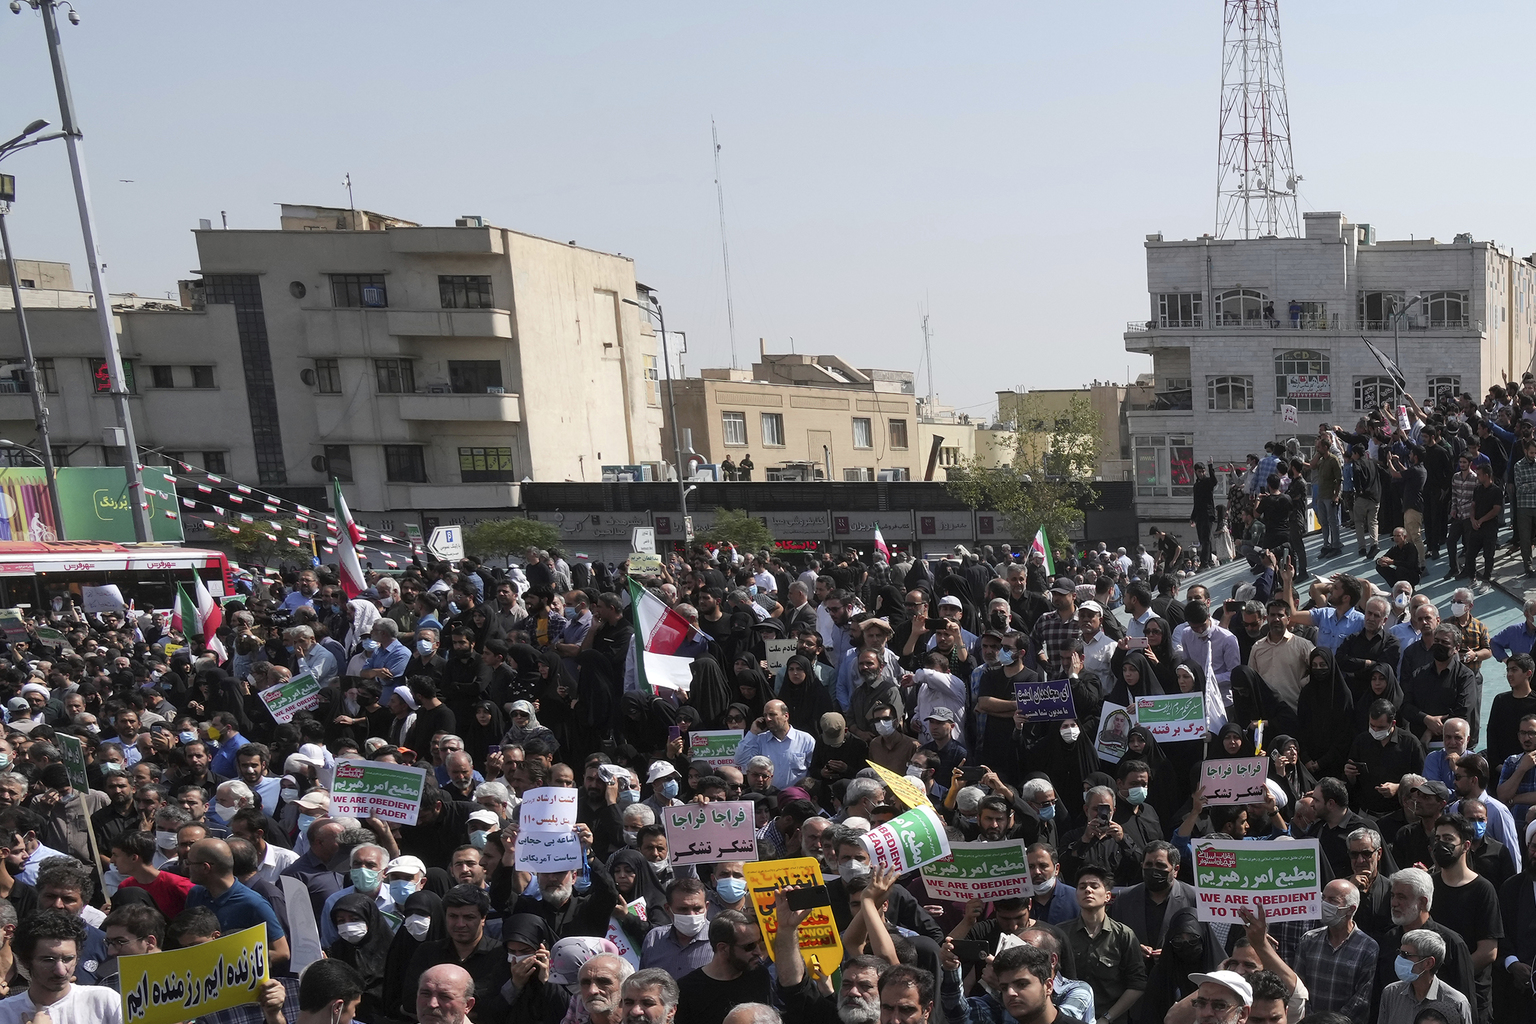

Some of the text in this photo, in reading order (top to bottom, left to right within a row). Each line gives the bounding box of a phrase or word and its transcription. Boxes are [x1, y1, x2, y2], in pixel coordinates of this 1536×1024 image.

[274, 705, 296, 718] WE ARE
[1183, 723, 1204, 736] مرگ
[1206, 761, 1262, 780] فراجا فراجا
[388, 784, 419, 796] مطیع
[1233, 785, 1264, 802] تشکر
[349, 796, 367, 804] ARE
[369, 797, 417, 811] OBEDIENT
[371, 807, 407, 820] EADER
[671, 807, 746, 830] فراجا فراجا
[672, 840, 754, 862] تشکر تشکر
[877, 825, 903, 872] BEDIENT
[989, 860, 1025, 876] مطیع
[1275, 865, 1316, 887] مطیع
[926, 877, 1027, 890] WE ARE OBEDIENT
[1200, 870, 1250, 888] رهبریم
[936, 887, 1021, 900] TO THE LEADER
[1200, 891, 1317, 905] WE ARE OBEDIENT
[1209, 905, 1307, 918] TO EADER
[203, 953, 225, 1003] ایم
[126, 970, 149, 1024] ایم
